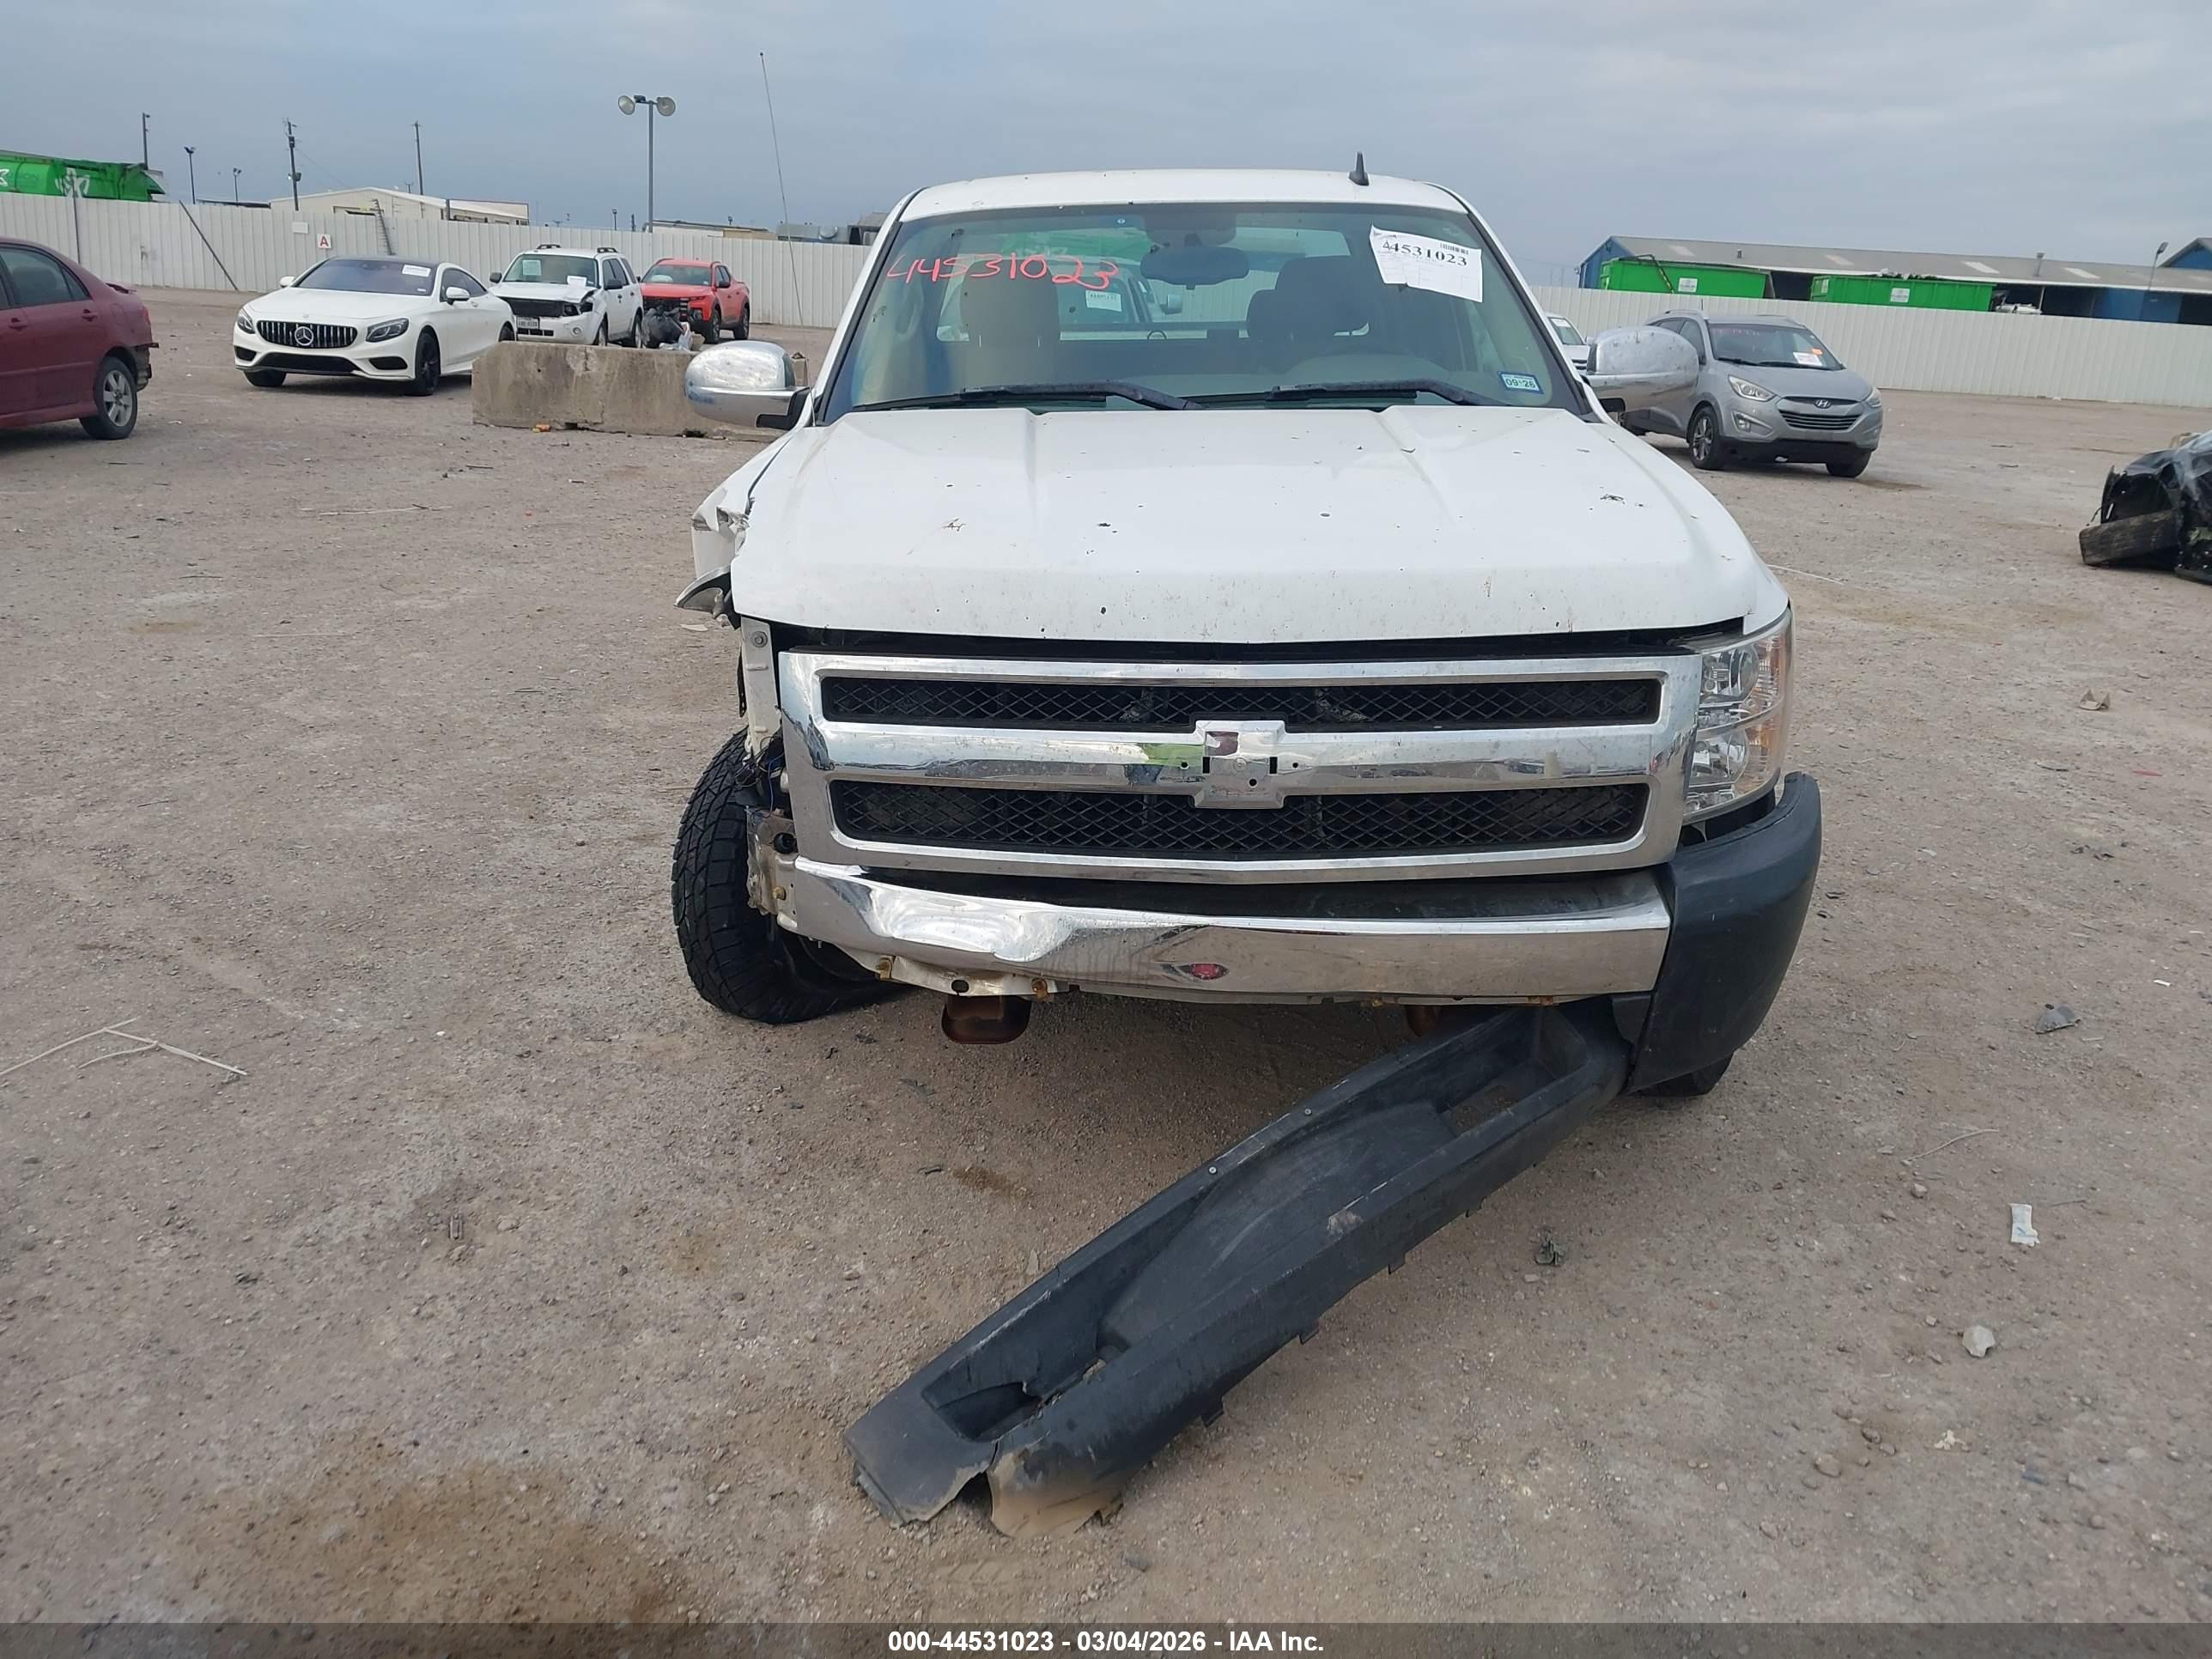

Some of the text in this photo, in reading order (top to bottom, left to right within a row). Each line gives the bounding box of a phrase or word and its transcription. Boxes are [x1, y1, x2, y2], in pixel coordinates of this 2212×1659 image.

[319, 235, 330, 247] A
[1382, 240, 1468, 266] 44531023
[886, 252, 1119, 289] 44531023
